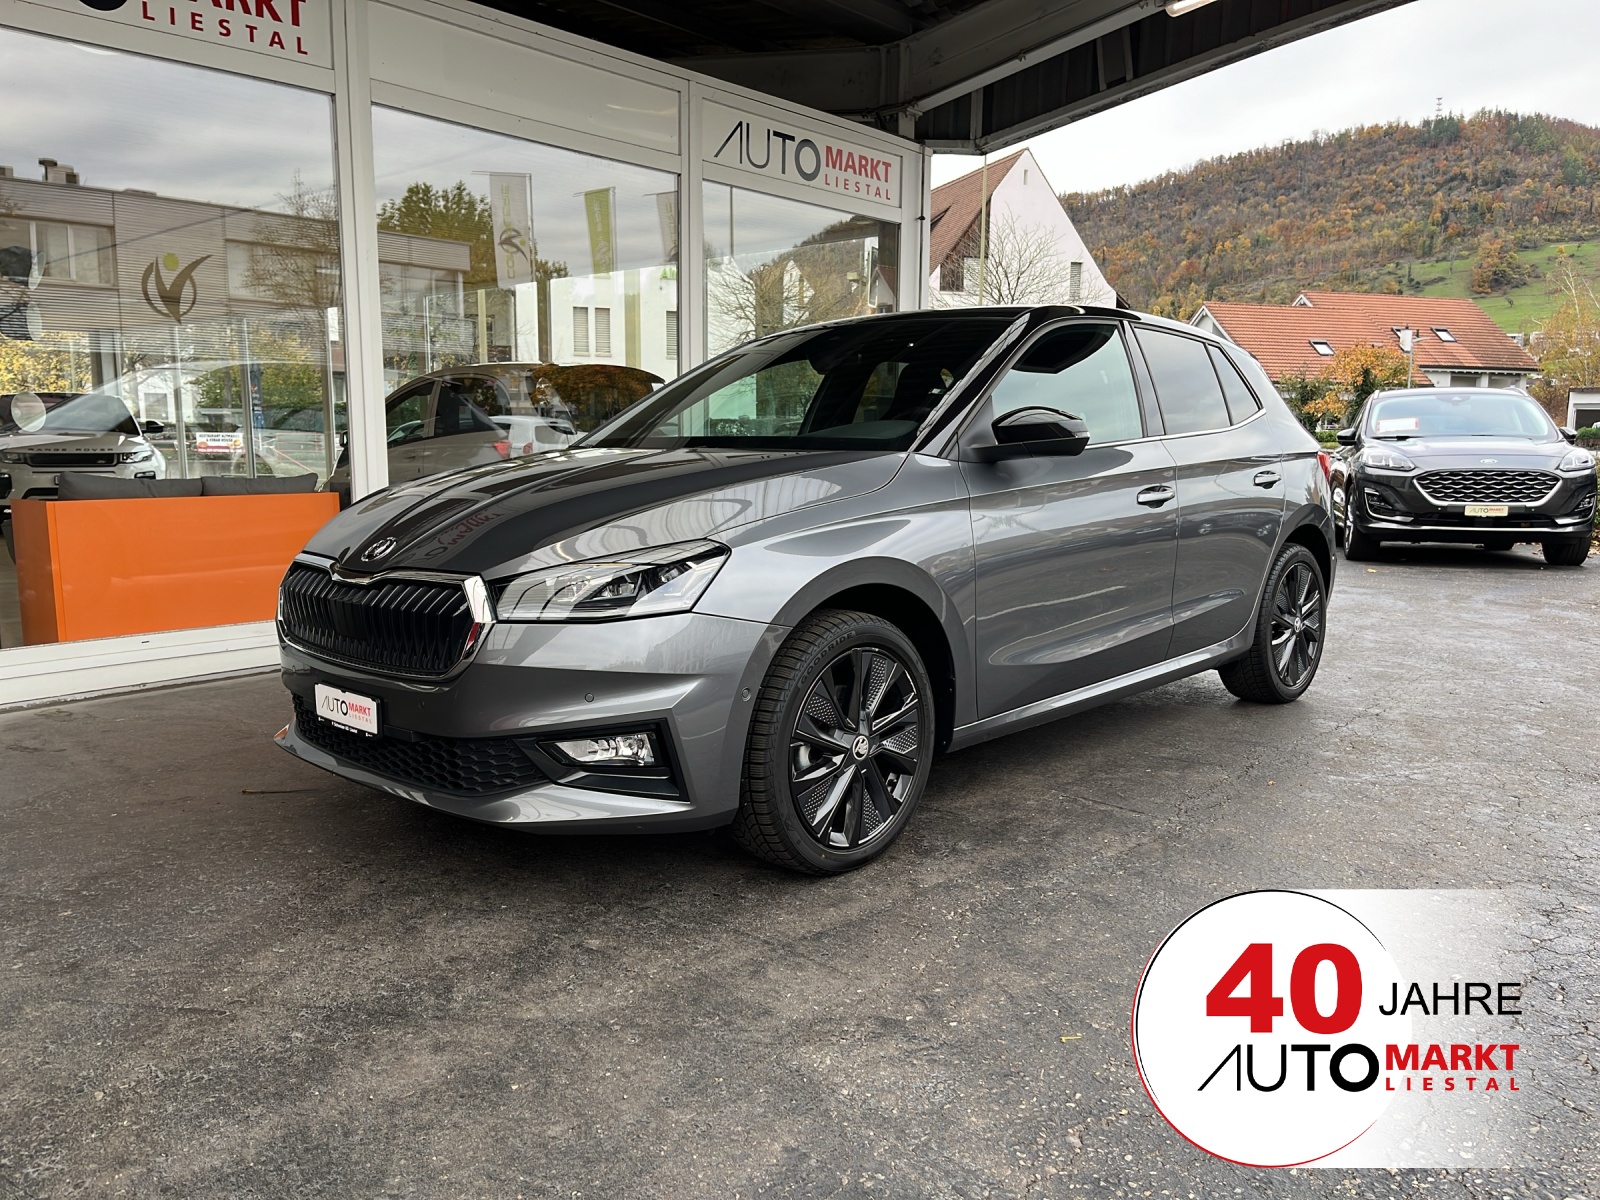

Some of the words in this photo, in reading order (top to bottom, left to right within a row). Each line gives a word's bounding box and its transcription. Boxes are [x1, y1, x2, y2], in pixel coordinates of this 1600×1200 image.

[142, 0, 308, 56] LIESTAL
[713, 120, 821, 182] AUTO
[825, 145, 892, 183] MARKT
[824, 173, 891, 201] LIESTAL
[801, 632, 854, 685] GOODRIDE
[321, 695, 348, 716] AUTO
[348, 702, 371, 717] MARKT
[349, 713, 372, 724] LIESTAL
